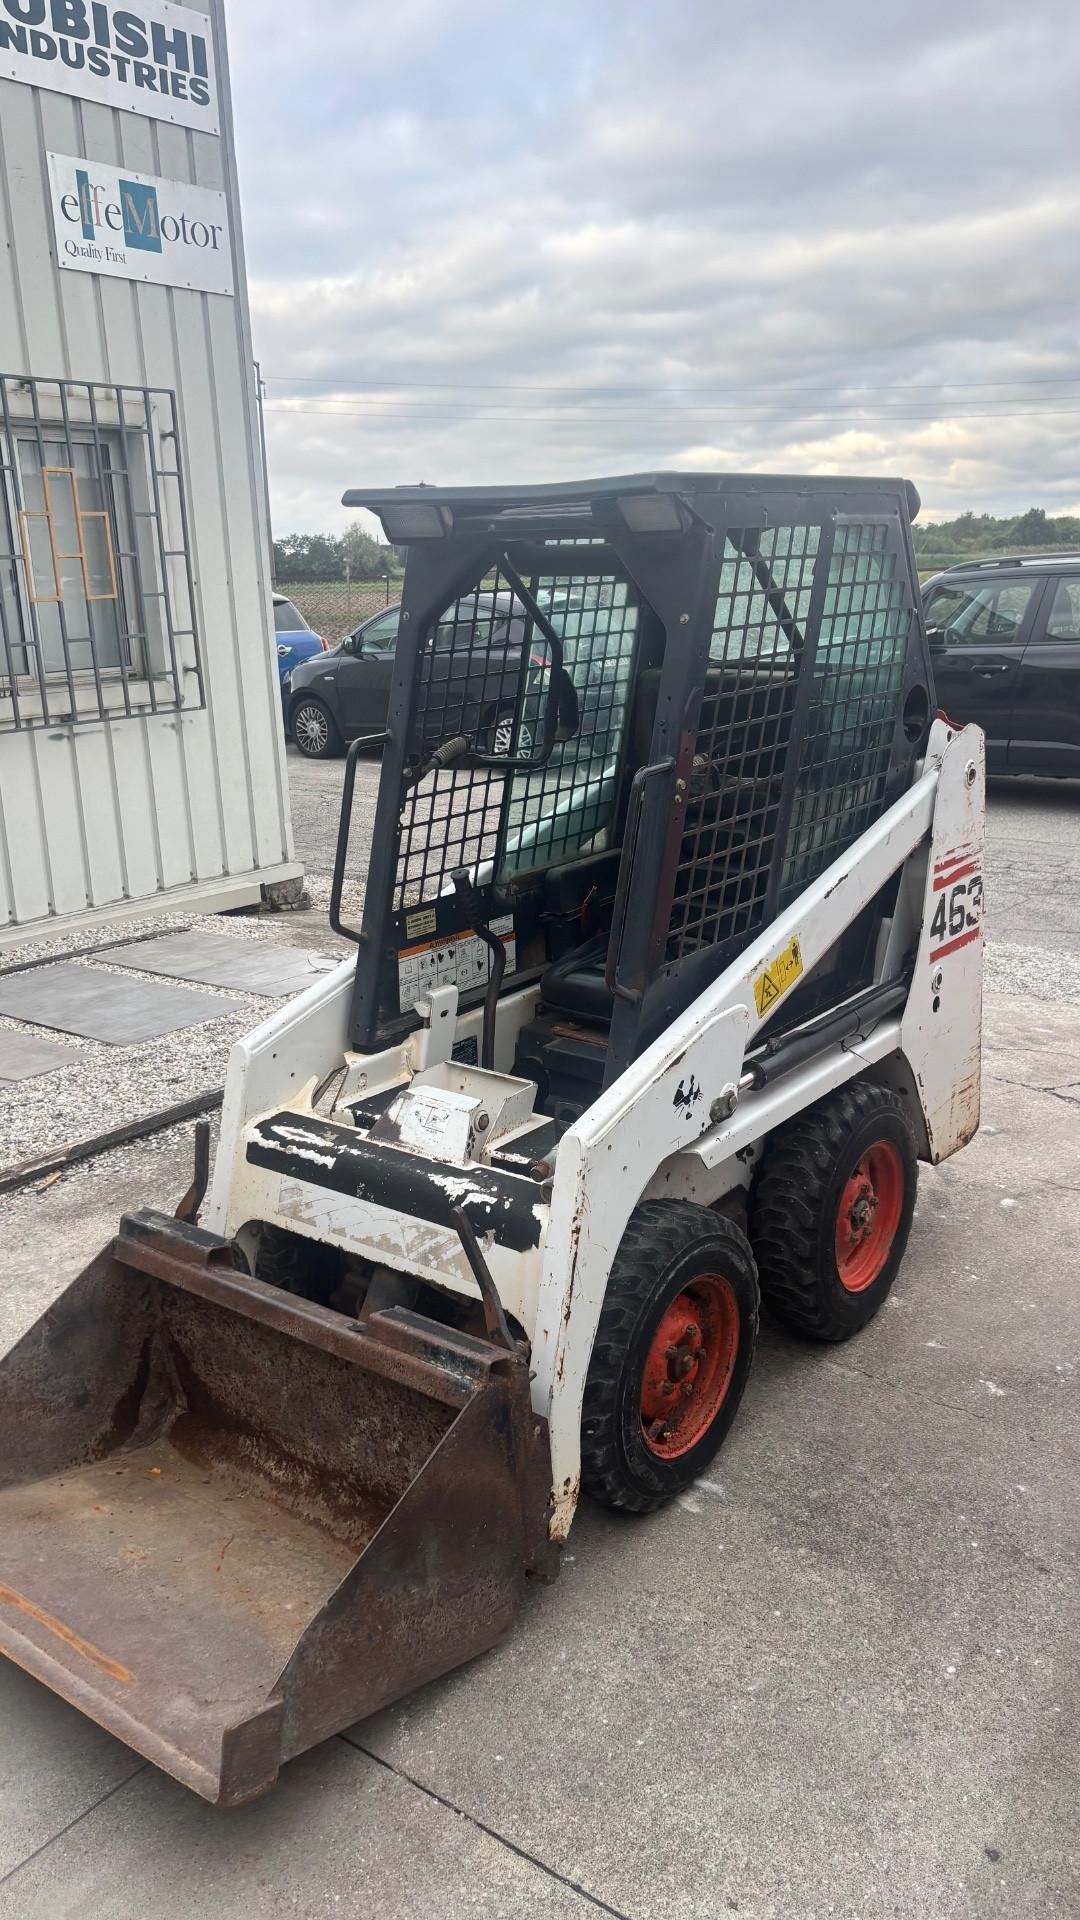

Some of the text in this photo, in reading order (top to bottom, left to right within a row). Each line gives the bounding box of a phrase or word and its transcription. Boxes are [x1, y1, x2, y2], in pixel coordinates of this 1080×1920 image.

[0, 20, 211, 106] NDUSTRIES
[60, 182, 223, 250] effeMotor
[65, 239, 127, 264] Quality First
[930, 875, 983, 942] 463
